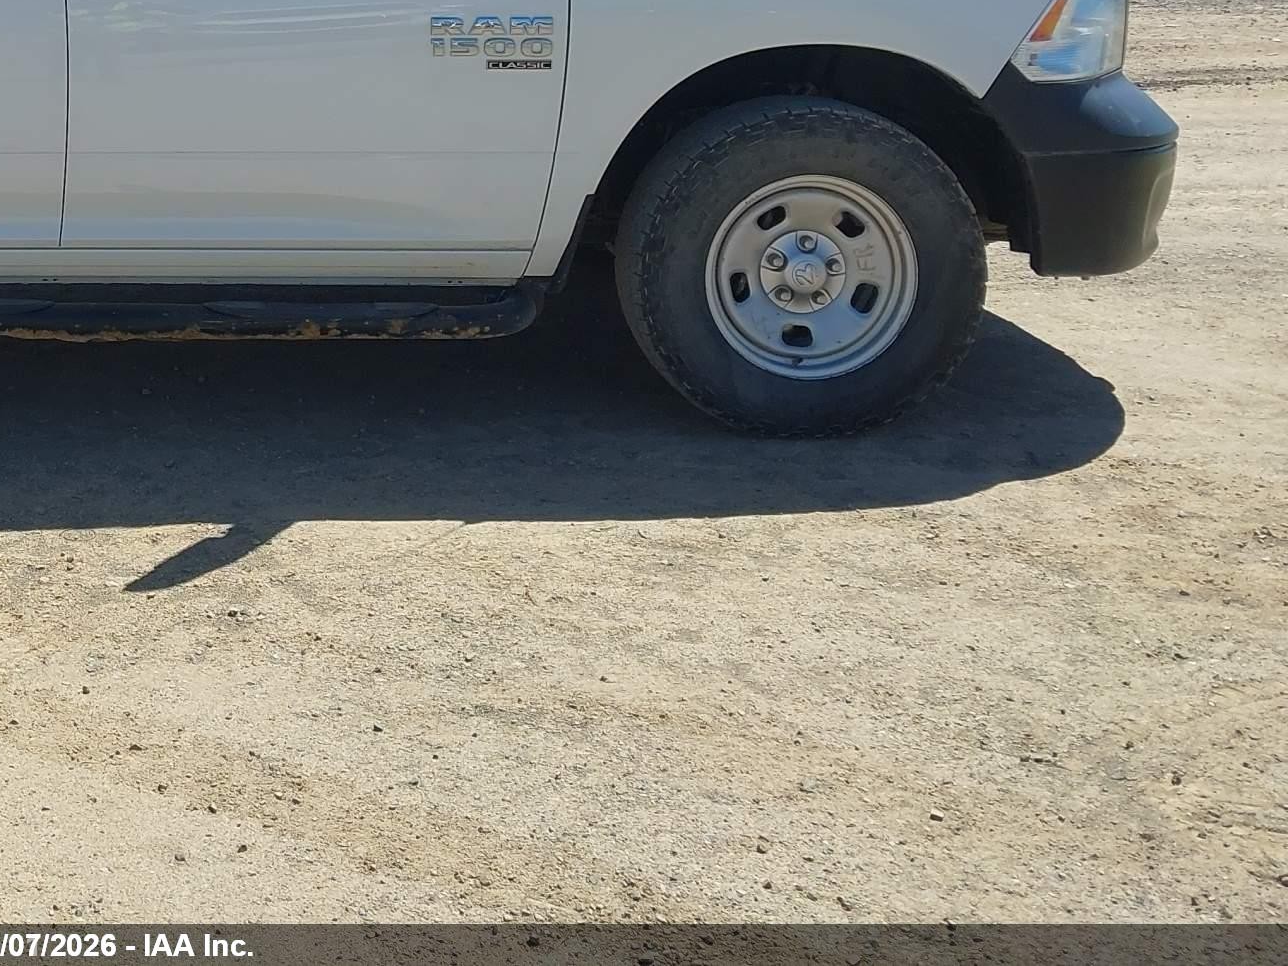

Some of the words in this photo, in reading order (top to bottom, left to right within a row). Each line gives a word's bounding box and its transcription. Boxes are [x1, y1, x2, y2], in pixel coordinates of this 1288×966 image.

[430, 16, 554, 35] RAM
[430, 37, 553, 57] 1500
[488, 61, 552, 69] CLASSIC
